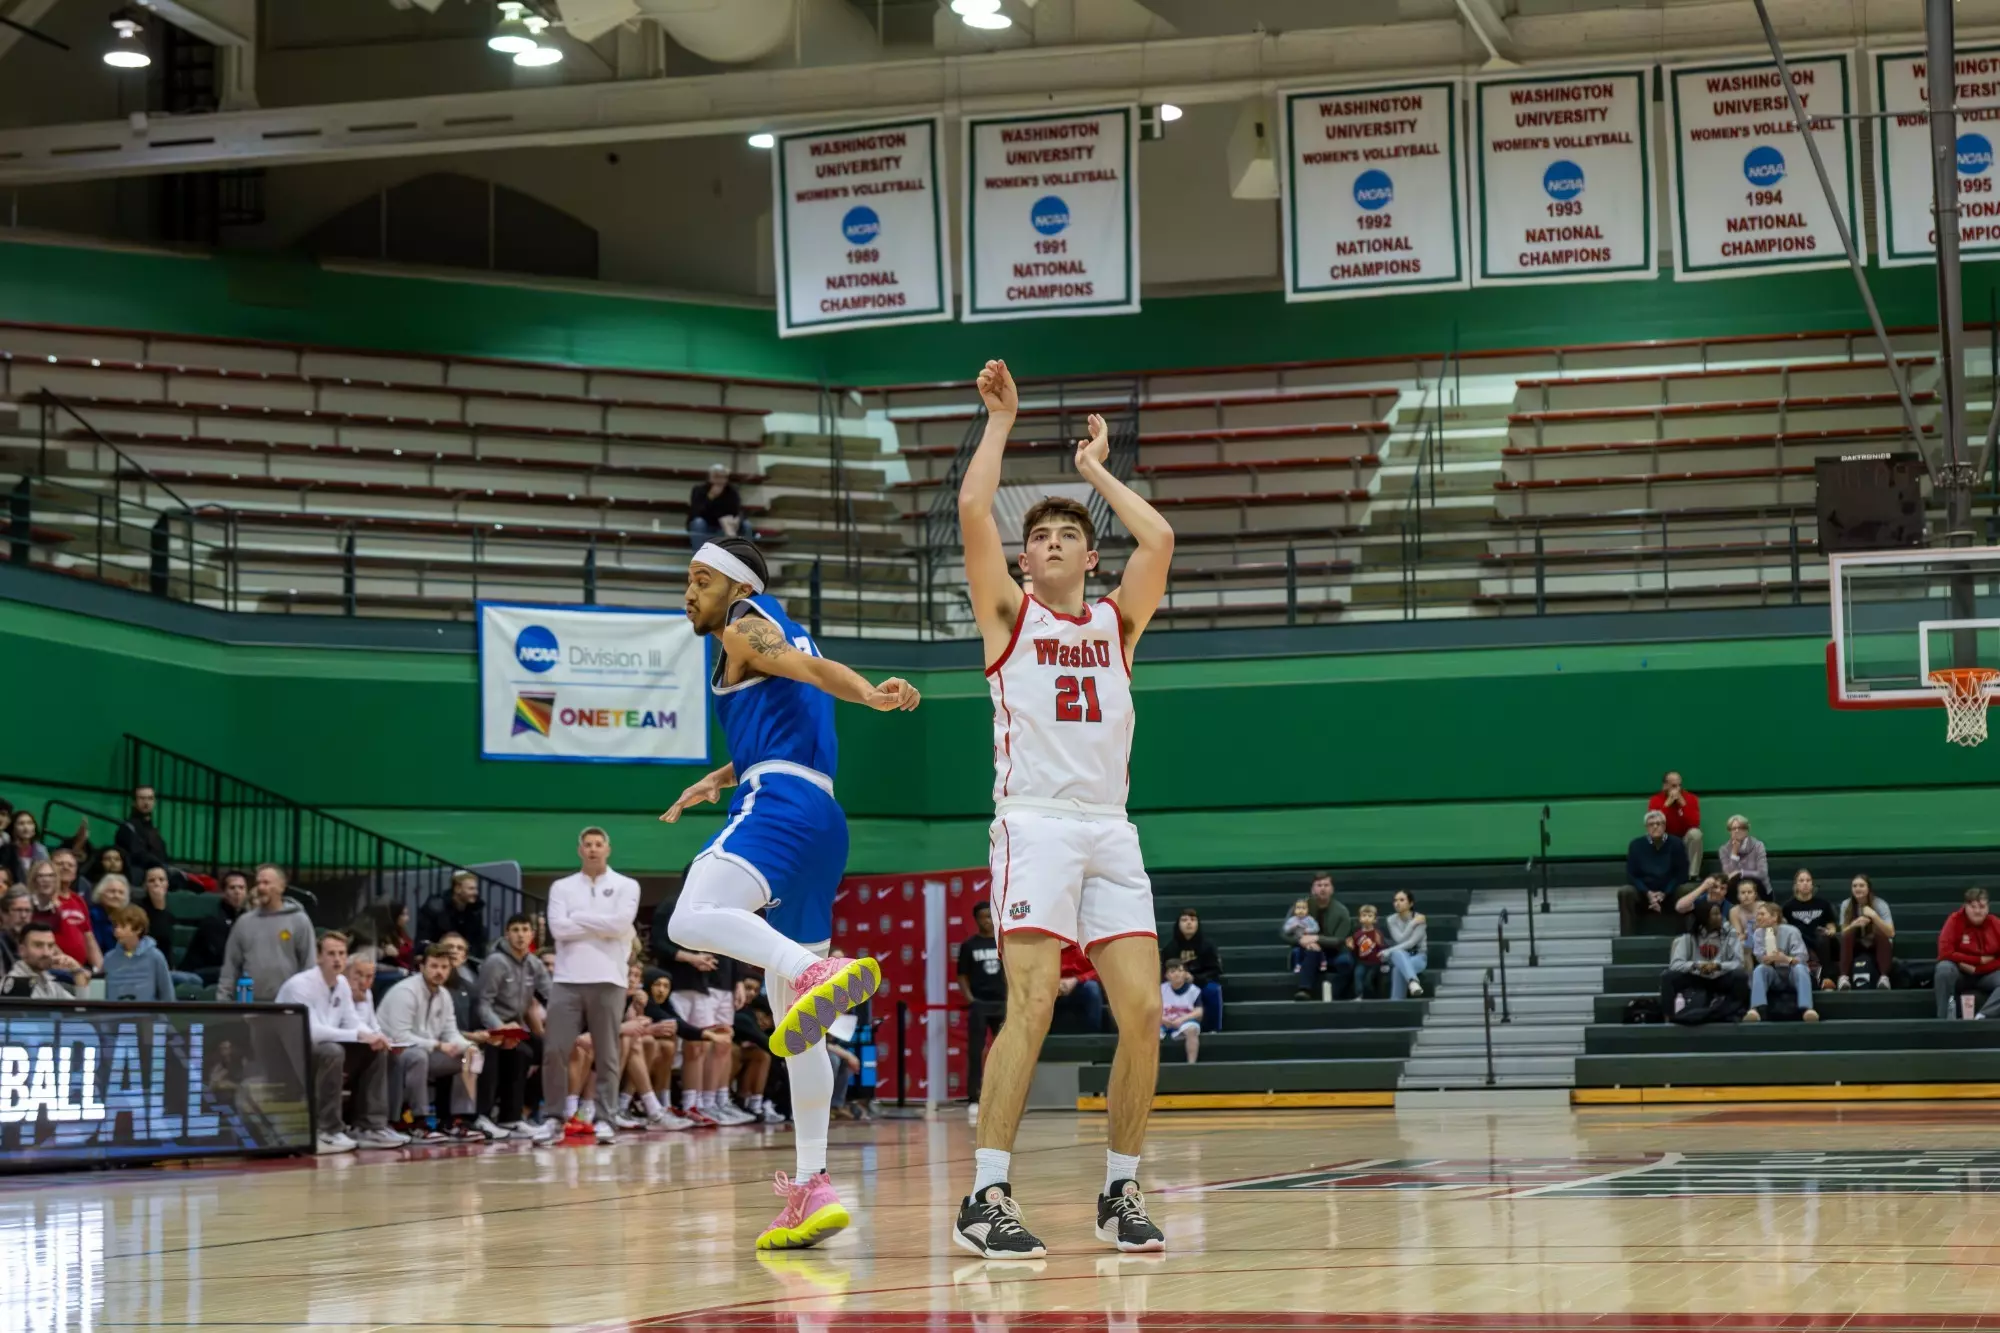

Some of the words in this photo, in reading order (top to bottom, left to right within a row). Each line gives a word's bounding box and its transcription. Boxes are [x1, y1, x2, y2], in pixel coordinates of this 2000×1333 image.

[1706, 70, 1814, 93] WASHINGON
[1510, 83, 1614, 105] WASHINGTON
[1319, 96, 1422, 117] WASHINGTON
[1713, 94, 1809, 116] UNIVERSIY
[1515, 107, 1609, 128] UNIVERSITY
[1001, 121, 1099, 144] WASHINGTON
[1326, 118, 1418, 140] UNIVERSITY
[1690, 125, 1750, 142] WOMEN'S
[809, 132, 906, 157] WASHINGTON
[1492, 136, 1550, 152] WOMEN'S
[1553, 131, 1633, 149] VOLLEYBALL
[1006, 144, 1095, 165] UNIVERSITY
[1303, 149, 1359, 165] WOMEN'S
[1363, 143, 1440, 161] VOLLEYBALL
[816, 155, 902, 178] UNIVERSITY
[1748, 164, 1786, 177] NCAA
[984, 174, 1039, 190] WOMEN'S
[1042, 168, 1117, 186] VOLLEYBALL
[1547, 179, 1586, 192] NCAA
[1957, 177, 1992, 193] 1995
[796, 184, 849, 203] WOMEN'S
[852, 178, 925, 197] VOLLEYBALL
[1358, 188, 1393, 200] NCAA
[1746, 190, 1783, 207] 1994
[1546, 201, 1583, 217] 1993
[1356, 214, 1392, 230] 1992
[1727, 213, 1807, 233] NATIONAL
[1525, 224, 1603, 243] NATIONAL
[1034, 240, 1067, 254] 1991
[1336, 236, 1413, 255] NATIONAL
[1721, 235, 1816, 257] CHAMPIONS
[846, 248, 880, 264] 1989
[1519, 247, 1611, 267] CHAMPIONS
[1013, 261, 1086, 279] NATIONAL
[1330, 258, 1421, 280] CHAMPIONS
[826, 271, 898, 290] NATIONAL
[1006, 282, 1093, 301] CHAMPIONS
[820, 292, 906, 312] CHAMPIONS
[519, 646, 560, 662] NCAA
[568, 645, 643, 668] Division
[1033, 638, 1110, 668] WashU
[1055, 674, 1102, 723] 21
[560, 707, 677, 729] ONETEAM
[1009, 904, 1031, 917] WASH
